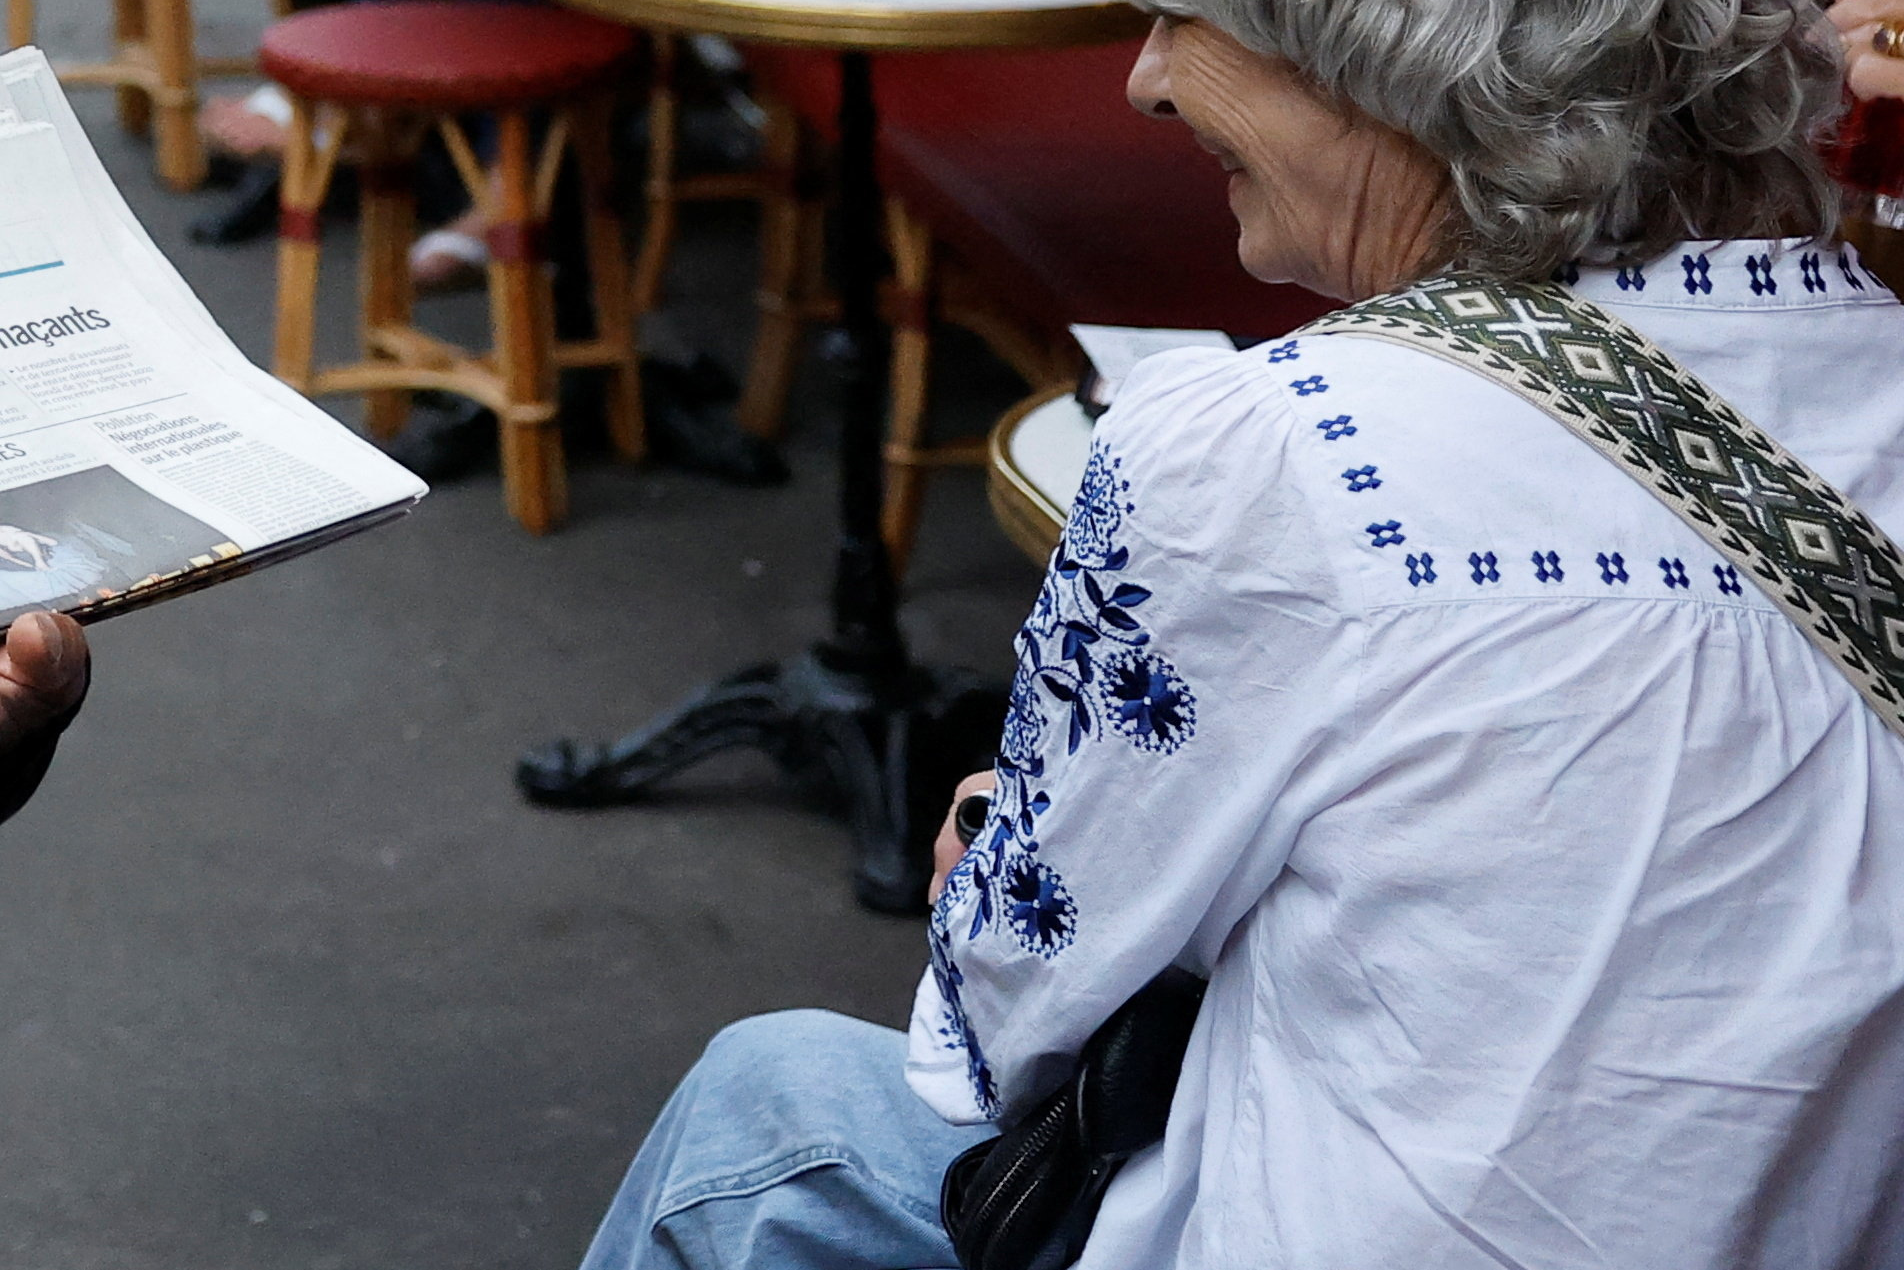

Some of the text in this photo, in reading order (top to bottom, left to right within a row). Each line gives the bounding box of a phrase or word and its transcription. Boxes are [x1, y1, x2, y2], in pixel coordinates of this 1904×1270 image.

[26, 371, 39, 379] de
[129, 374, 151, 387] pays
[60, 382, 74, 391] de
[4, 406, 17, 414] en
[94, 410, 158, 432] Pollution
[109, 414, 199, 443] Négociations
[125, 419, 228, 455] internationales
[141, 429, 243, 466] sur le plastique
